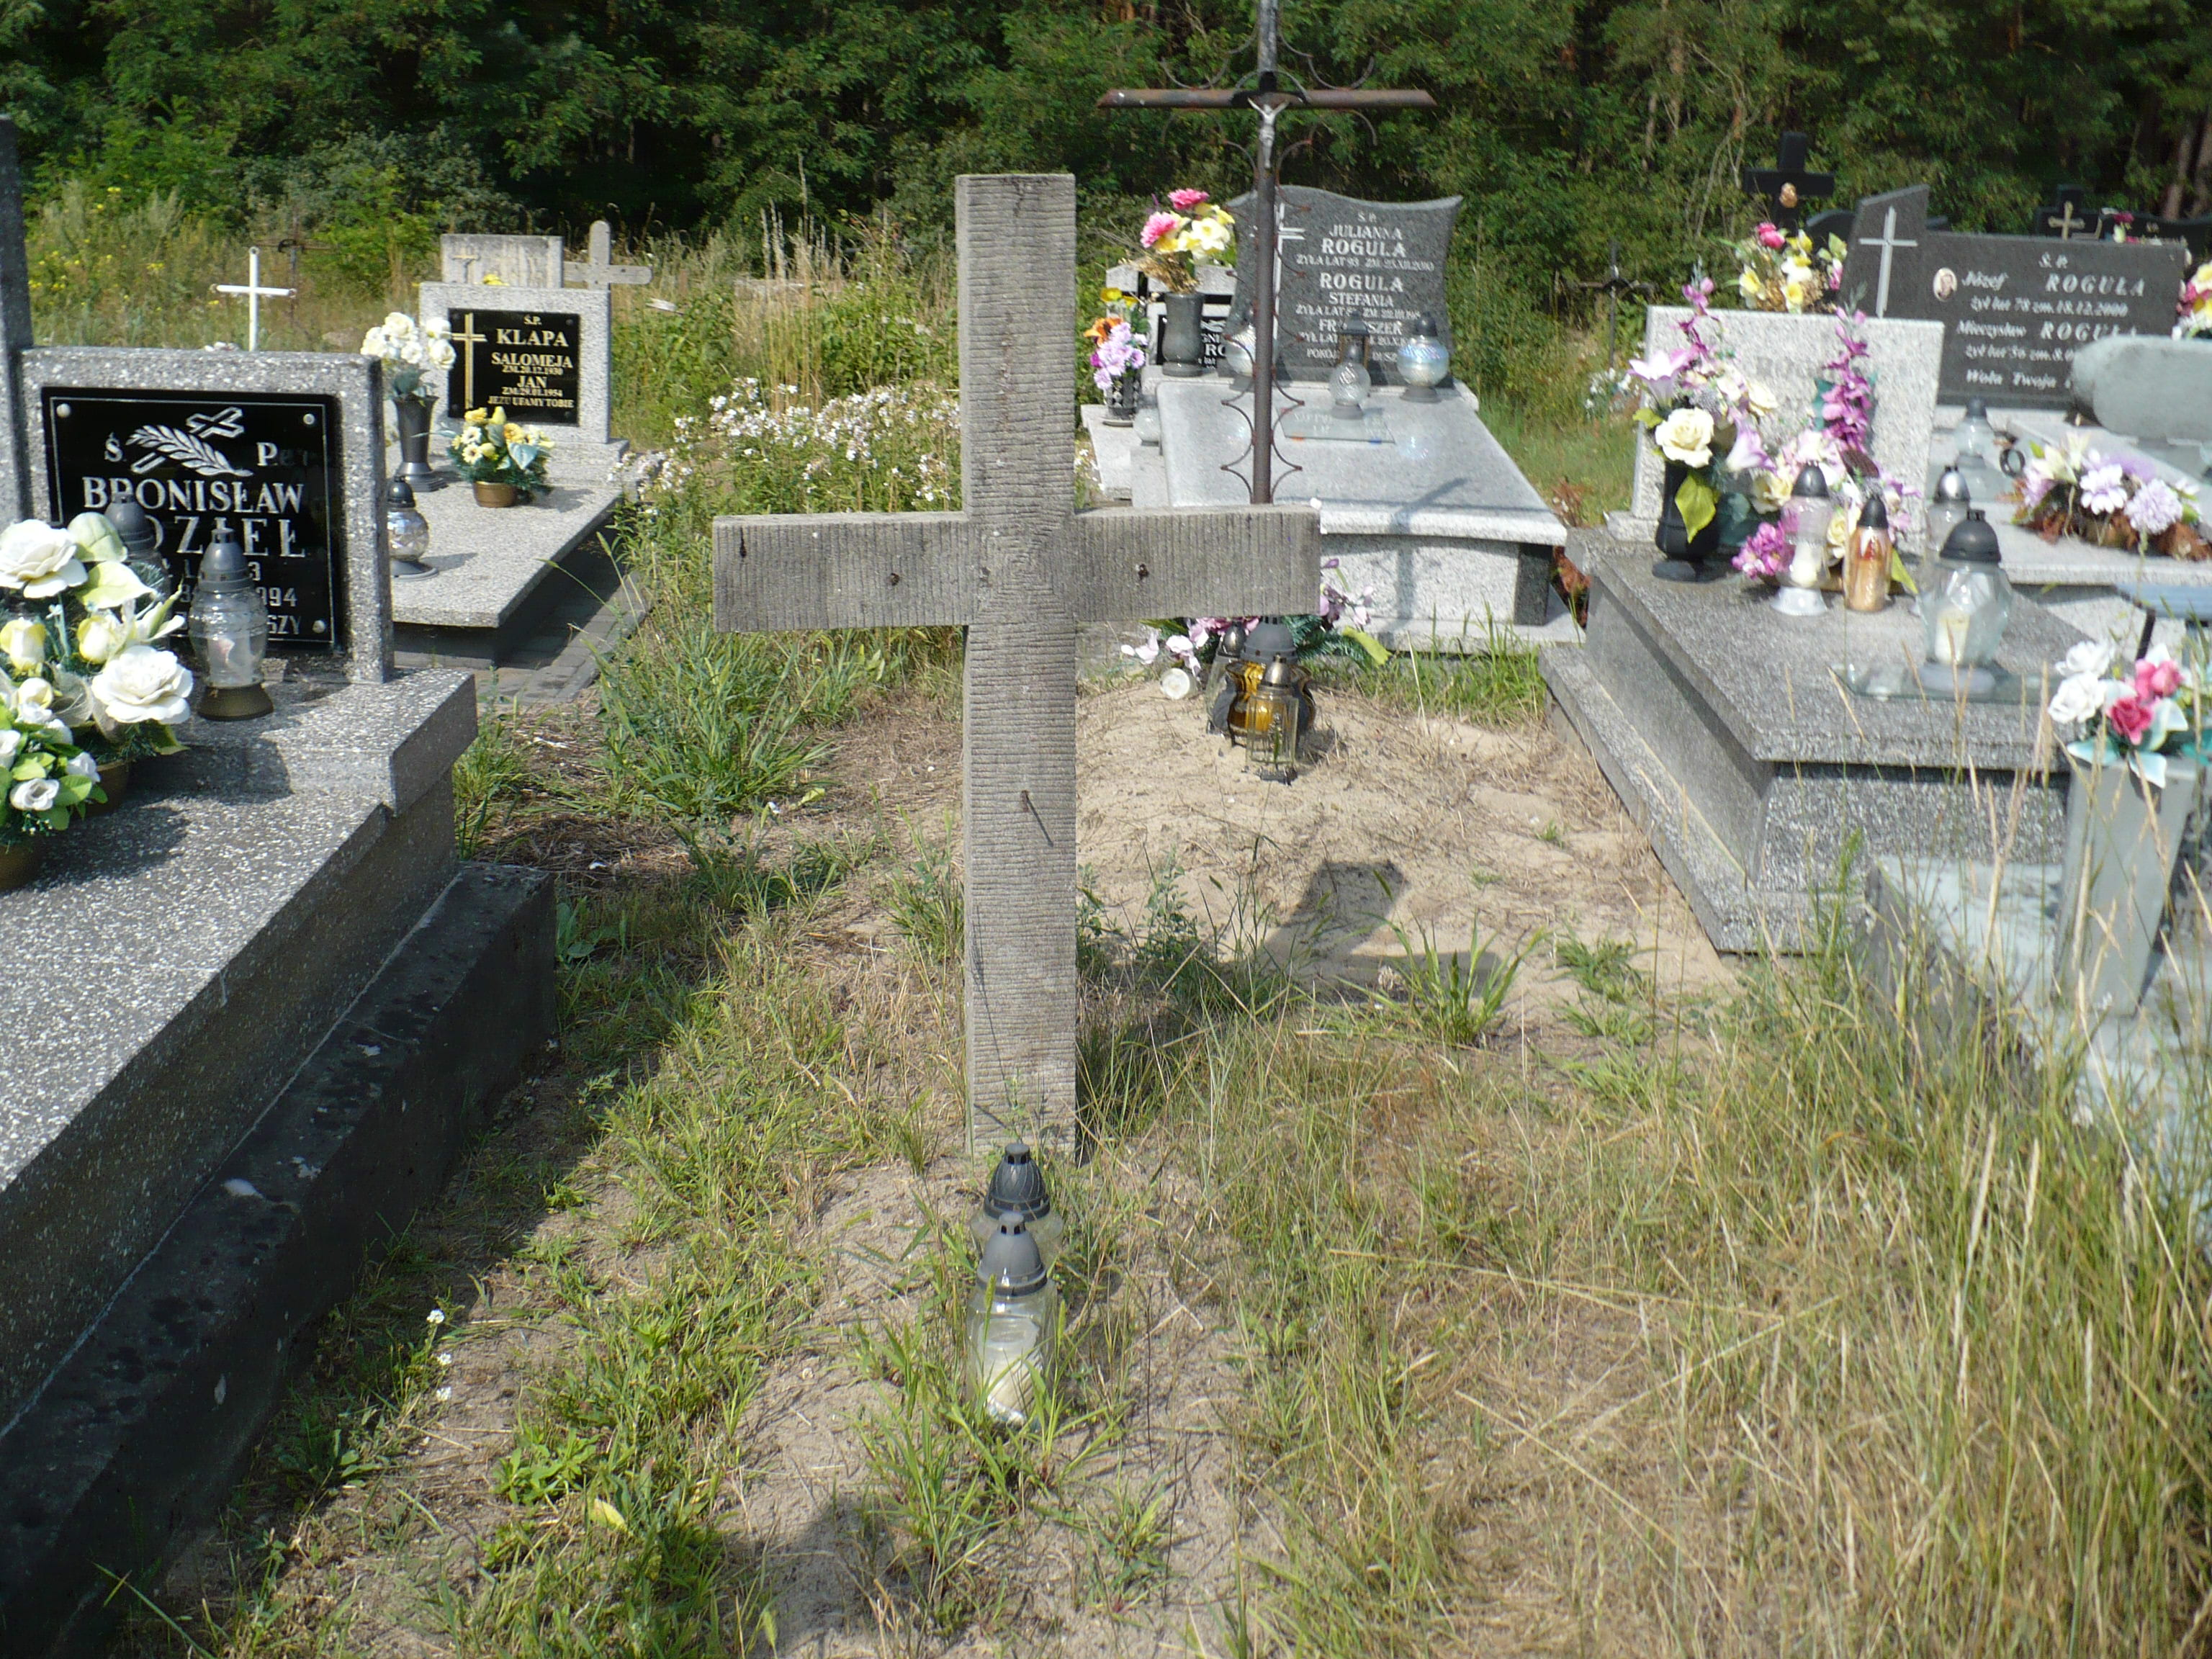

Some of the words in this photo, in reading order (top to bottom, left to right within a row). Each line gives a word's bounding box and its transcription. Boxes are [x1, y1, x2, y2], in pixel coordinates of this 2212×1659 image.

[1328, 292, 1394, 307] STEFANIA
[496, 328, 570, 347] KLAPA
[491, 351, 574, 369] SALOMEJA
[517, 375, 548, 388] JAN
[82, 476, 304, 514] BRONISŁAW
